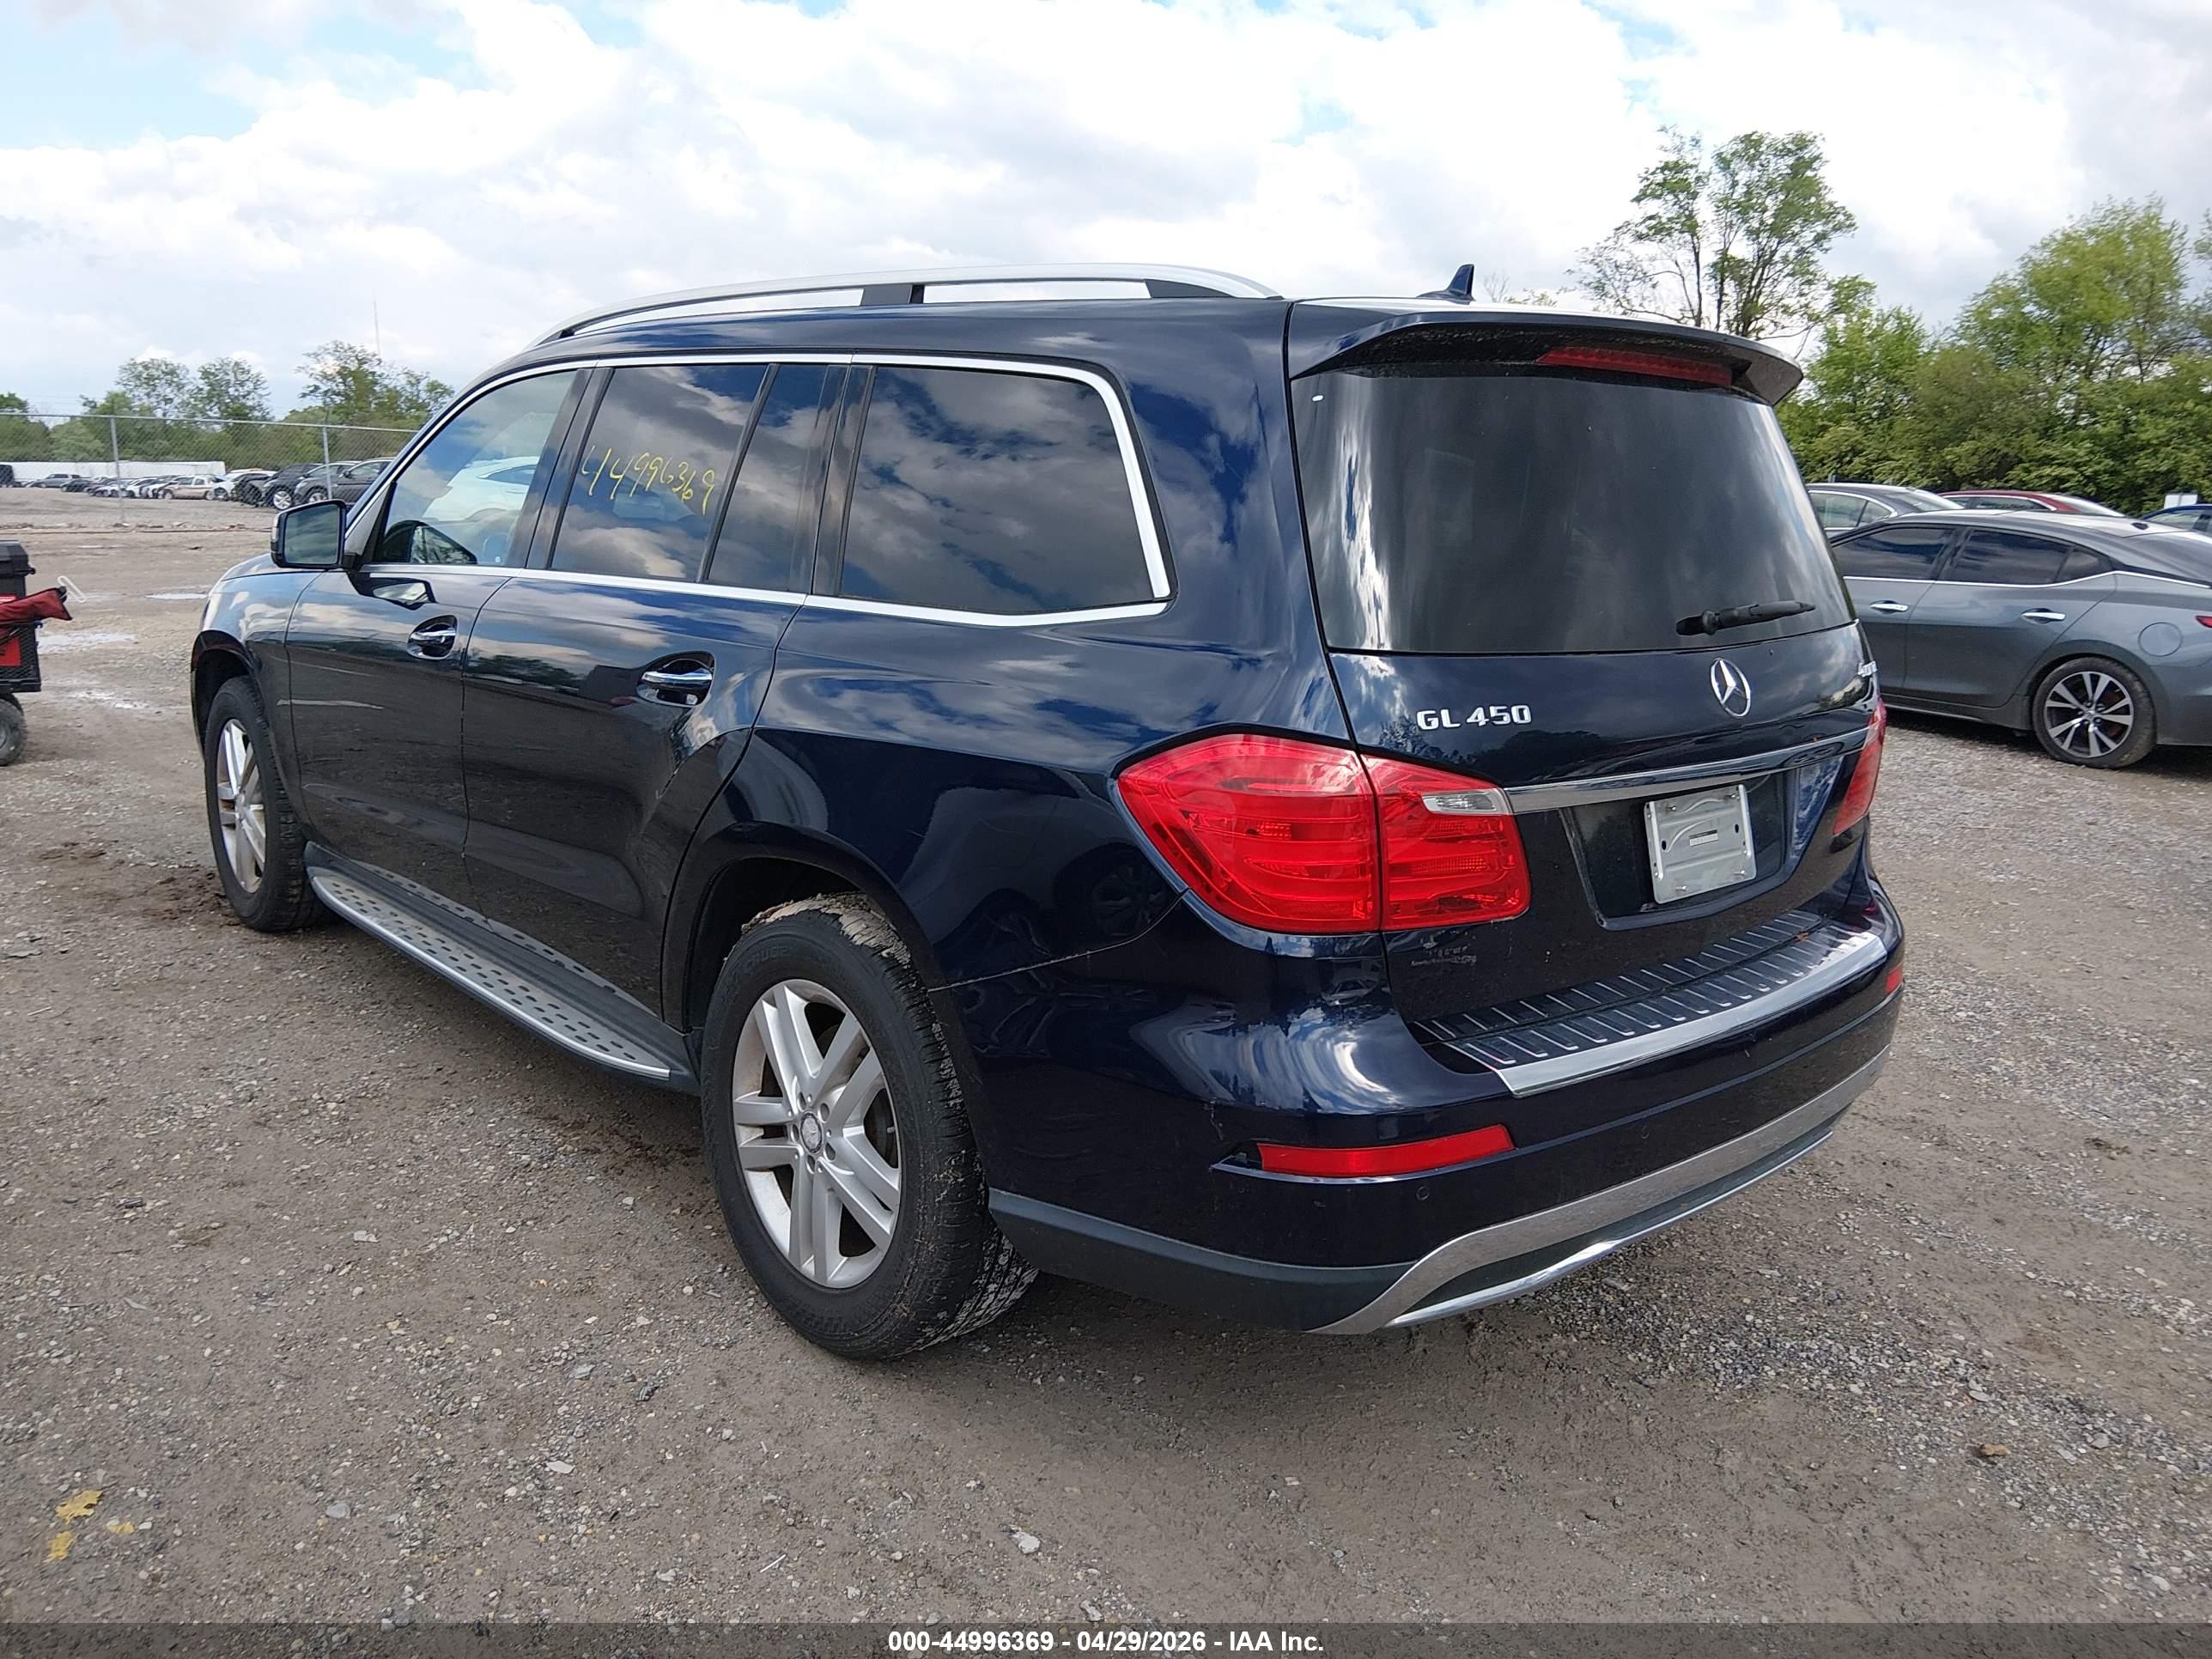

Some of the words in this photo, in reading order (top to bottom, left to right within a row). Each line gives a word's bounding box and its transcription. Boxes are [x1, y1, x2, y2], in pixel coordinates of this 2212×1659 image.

[580, 445, 716, 516] 44996369
[1416, 709, 1461, 731] GL
[1466, 704, 1532, 727] 450
